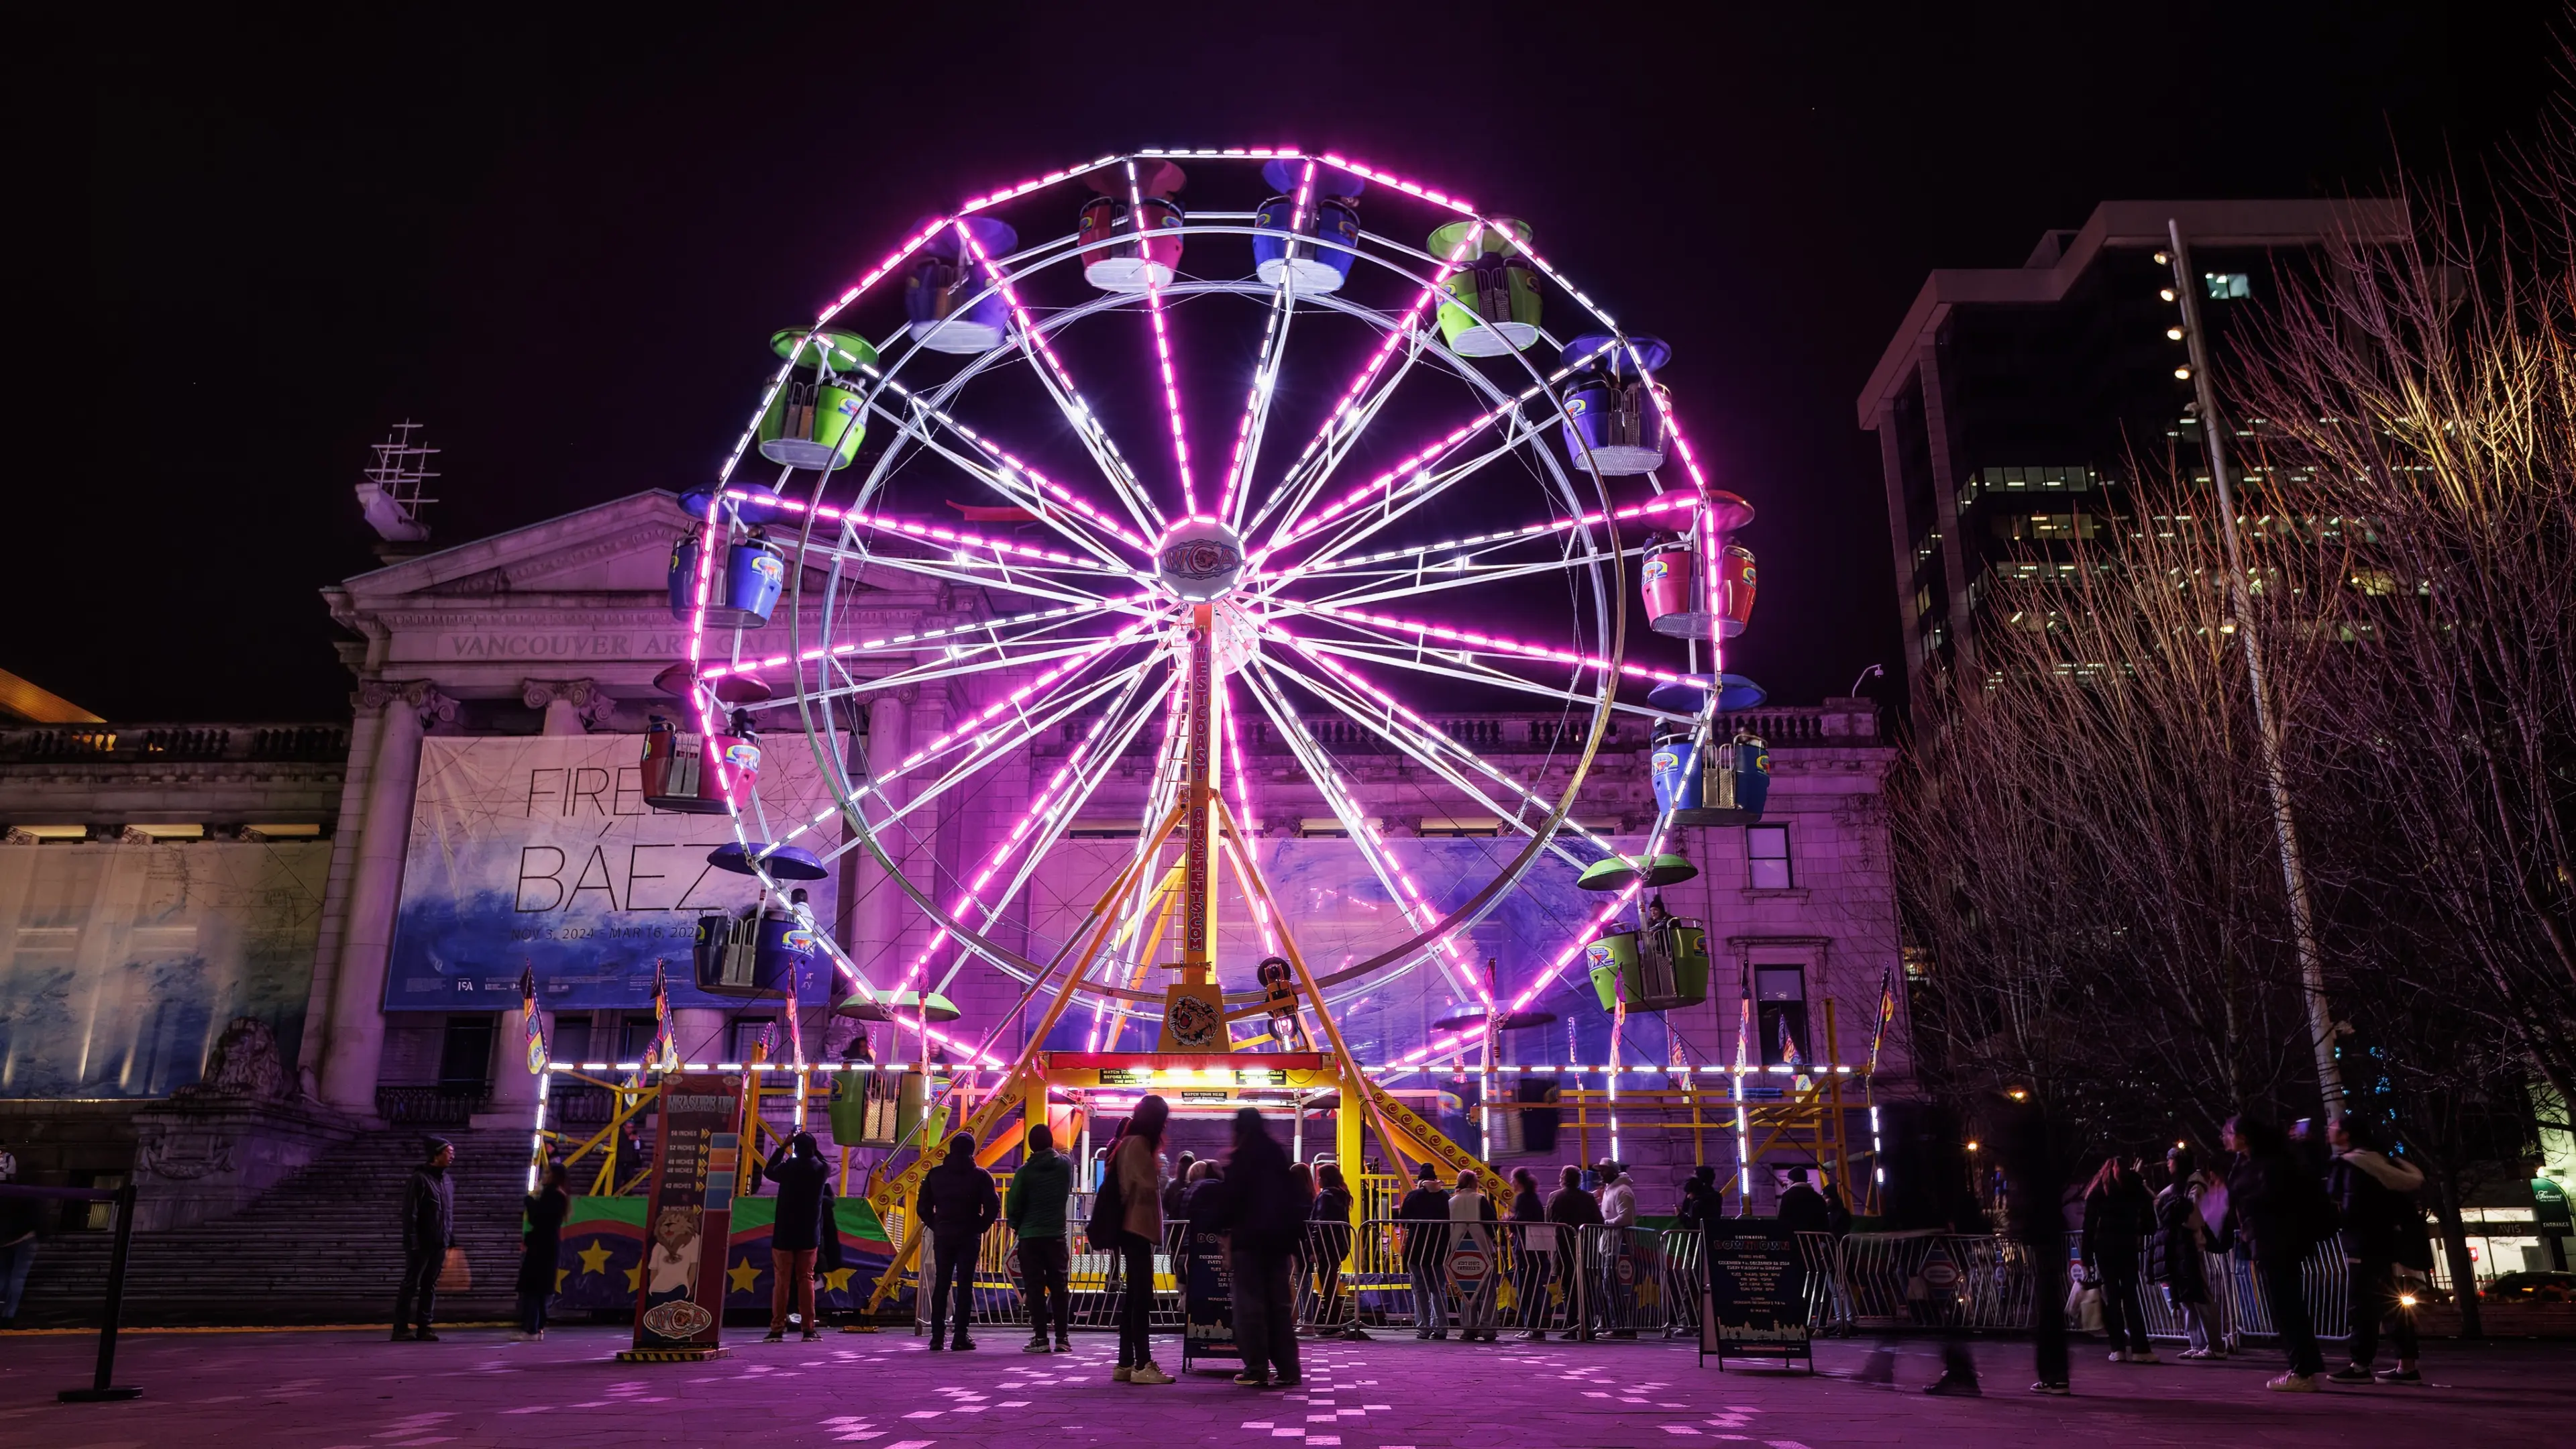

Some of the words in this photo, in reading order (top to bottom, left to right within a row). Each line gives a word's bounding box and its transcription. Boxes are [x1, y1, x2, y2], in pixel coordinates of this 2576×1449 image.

[1164, 545, 1237, 574] WCA
[451, 635, 629, 657] VANCOUVER
[515, 821, 726, 913] BÁEZ
[511, 928, 541, 940] NOV
[562, 928, 594, 939] 2024
[609, 928, 641, 938] MAR
[669, 927, 696, 938] 202
[667, 1095, 716, 1112] MEASURE
[2498, 1224, 2522, 1233] AVIS
[1713, 1240, 1790, 1250] DOWNTOWN
